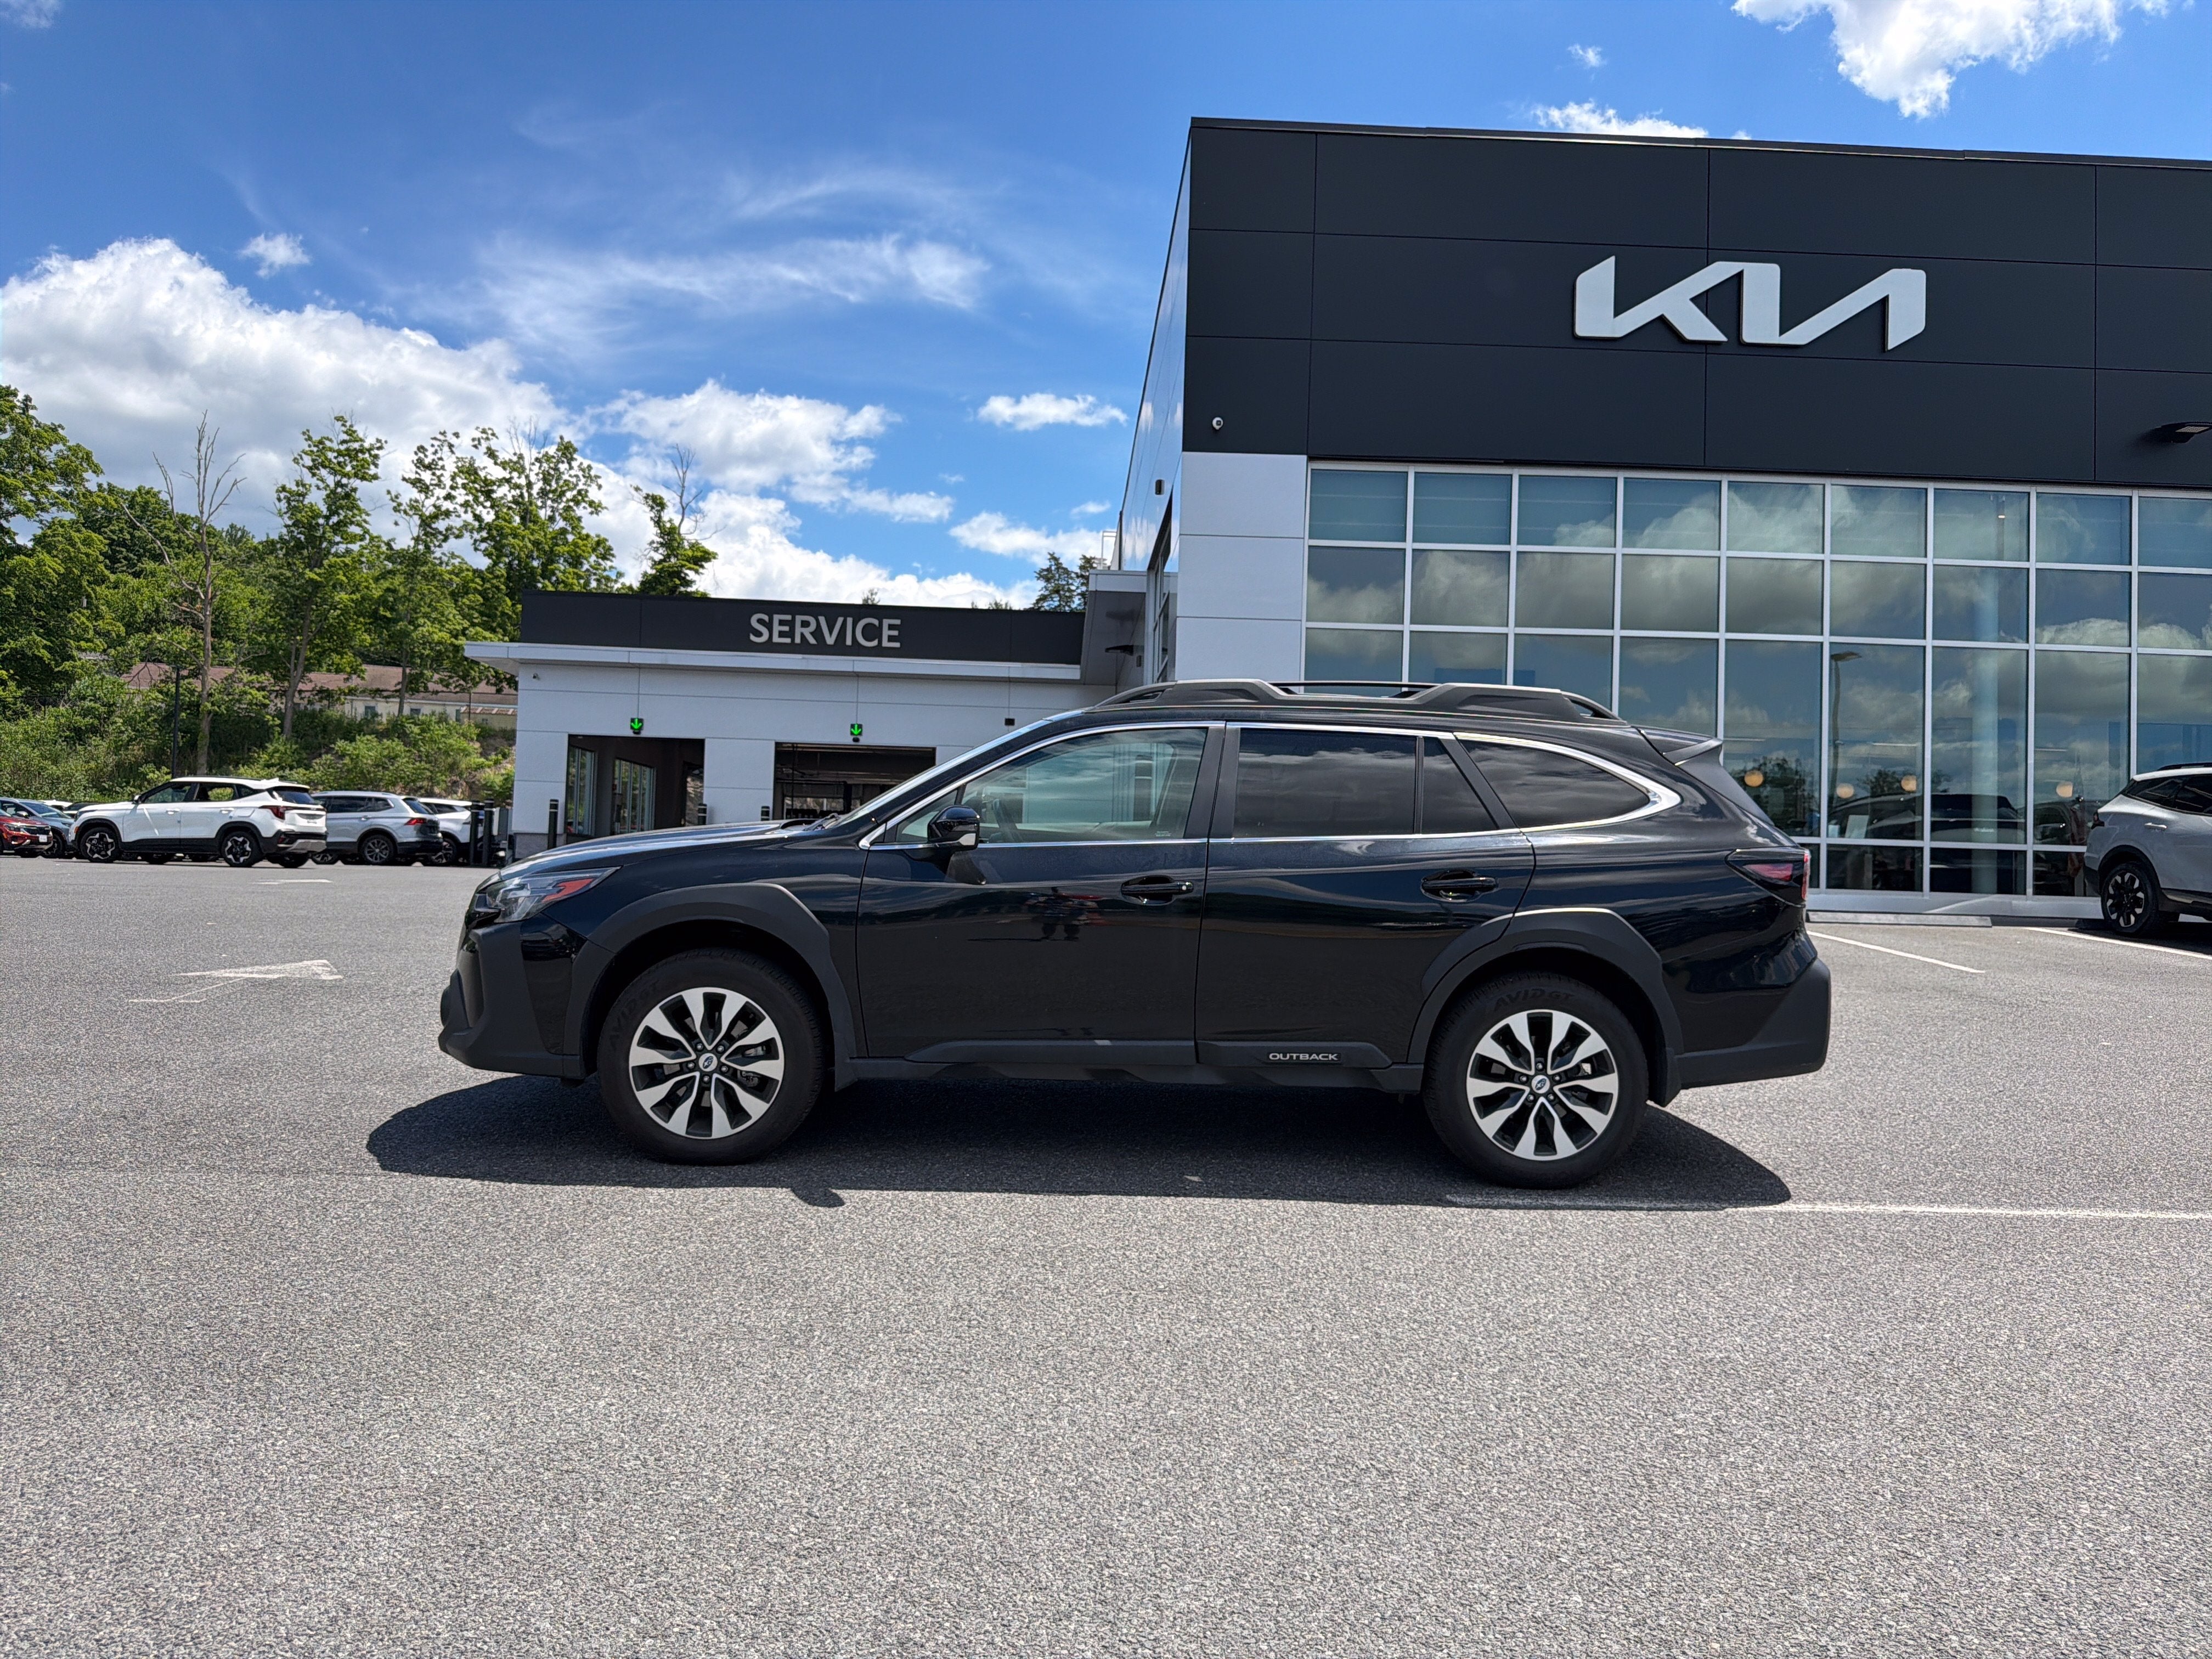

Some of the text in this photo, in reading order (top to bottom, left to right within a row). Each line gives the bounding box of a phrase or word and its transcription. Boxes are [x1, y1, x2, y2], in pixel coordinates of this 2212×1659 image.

[1574, 256, 1926, 352] KIA
[749, 613, 901, 648] SERVICE
[1494, 988, 1575, 1011] AVID GT
[1268, 1053, 1338, 1061] OUTBACK
